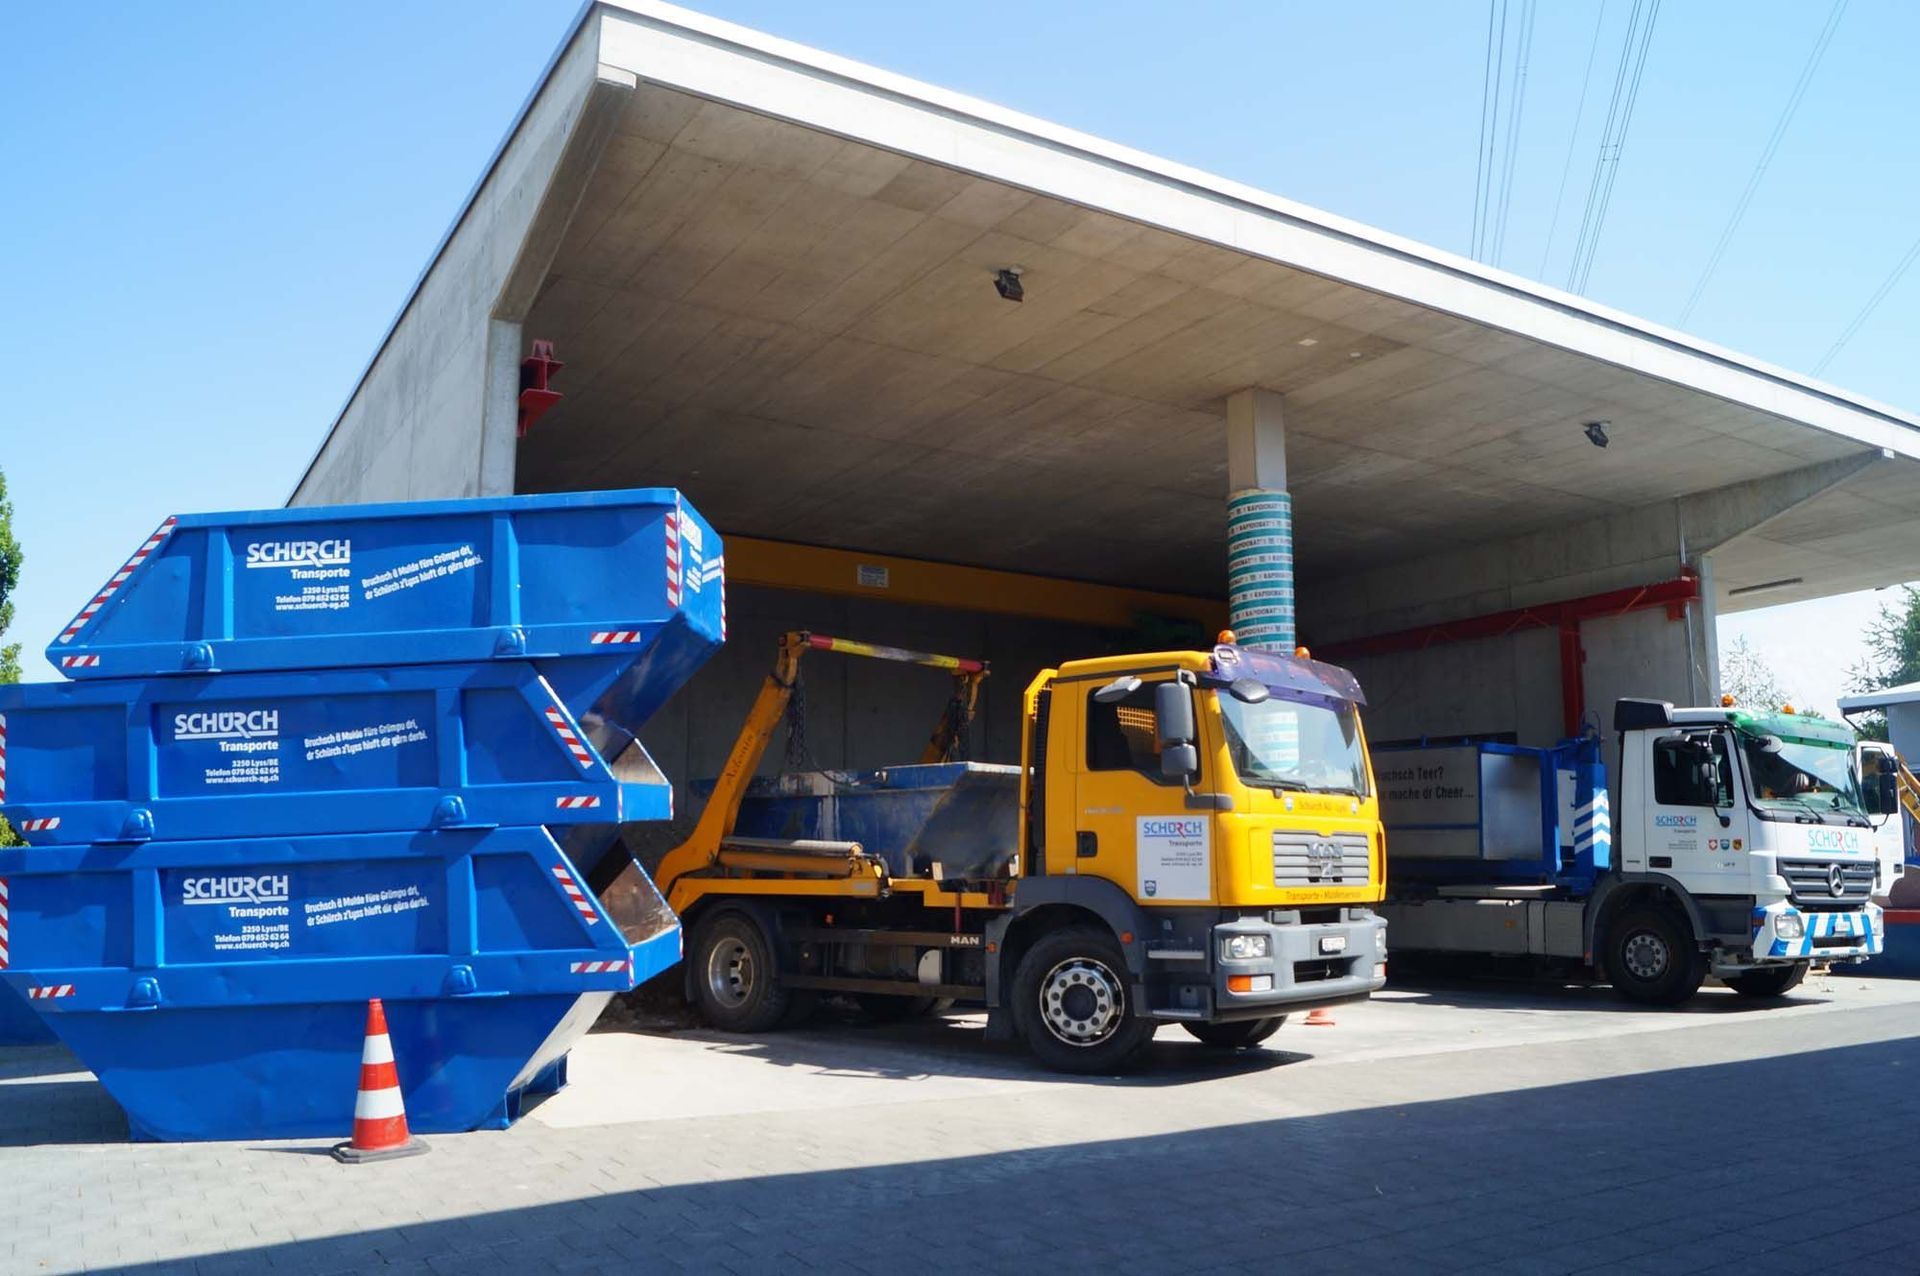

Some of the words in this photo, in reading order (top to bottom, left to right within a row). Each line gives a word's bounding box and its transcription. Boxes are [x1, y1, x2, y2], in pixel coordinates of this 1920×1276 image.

[246, 540, 351, 567] SCHÜRCH
[290, 568, 351, 580] Transporte
[275, 595, 302, 603] Telefon
[174, 710, 279, 739] SCHÜRCH
[219, 741, 279, 752] Transporte
[232, 760, 250, 768] 3250
[251, 758, 279, 767] Lyss/BE
[205, 769, 231, 777] Telefon
[231, 768, 245, 776] 079
[259, 767, 269, 775] 62
[205, 775, 279, 784] www.schuerch-ag.ch
[1656, 816, 1697, 827] SCHÜRCH
[1144, 821, 1202, 838] SCHÜRCH
[1808, 829, 1858, 852] SCHÜRCH
[183, 875, 289, 904] SCHÜRCH
[229, 906, 289, 919] Transporte
[315, 912, 343, 925] Schürch
[242, 925, 261, 933] 3250
[261, 924, 289, 933] Lyss/BE
[214, 935, 241, 943] Telefon
[241, 934, 255, 942] 079
[270, 933, 279, 941] 62
[950, 936, 980, 945] MAN
[214, 940, 290, 950] www.schuerch-ag.ch
